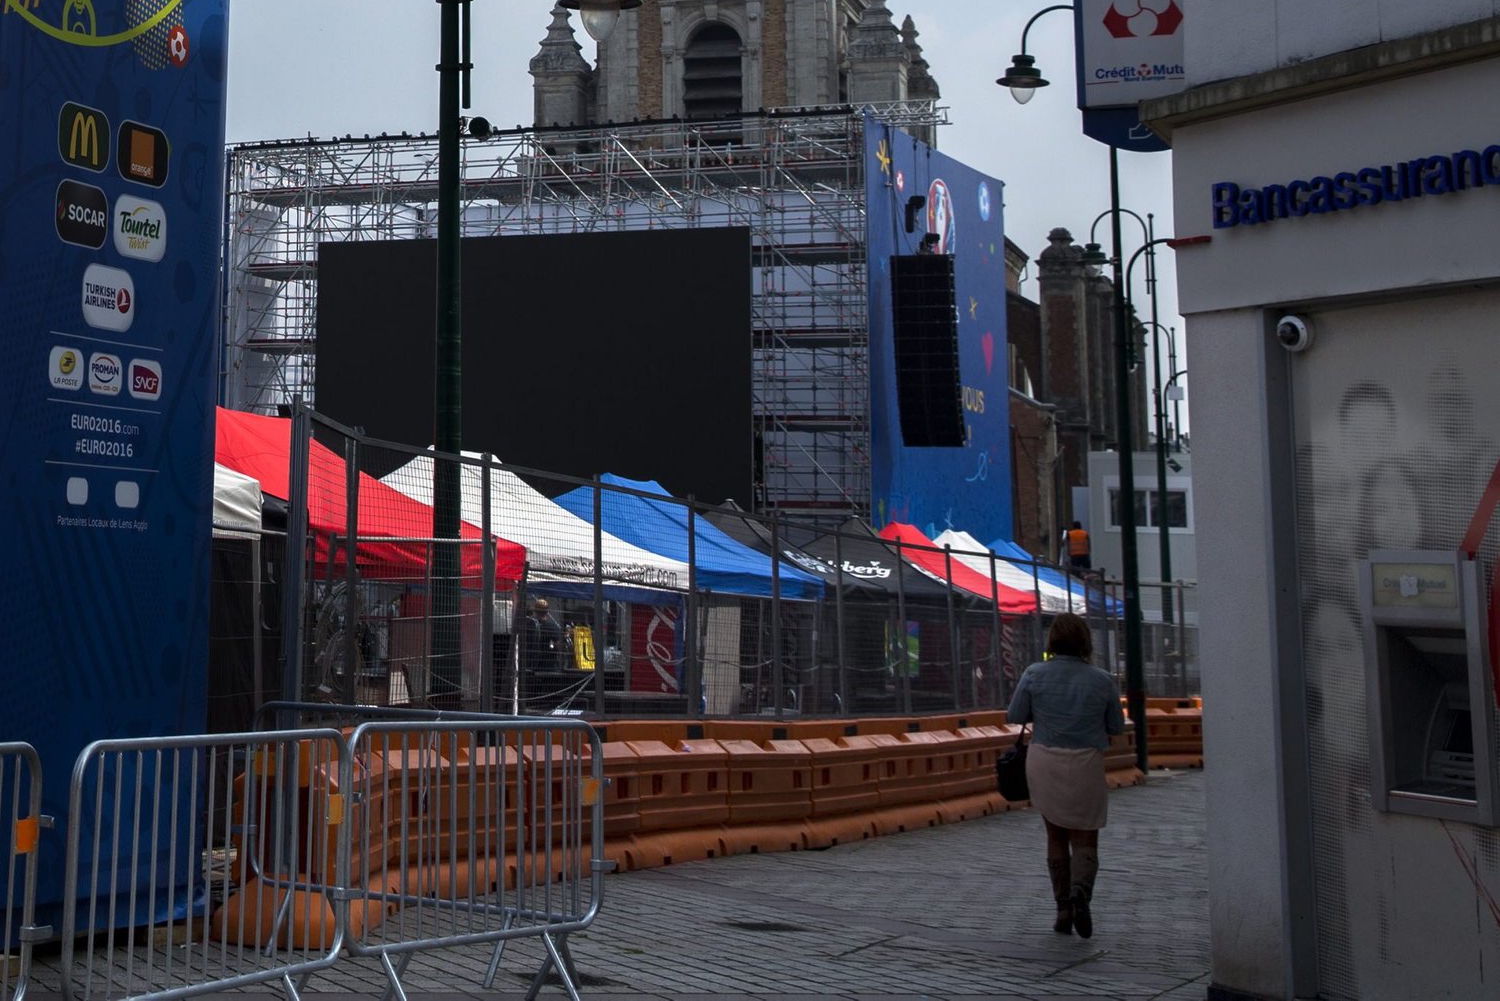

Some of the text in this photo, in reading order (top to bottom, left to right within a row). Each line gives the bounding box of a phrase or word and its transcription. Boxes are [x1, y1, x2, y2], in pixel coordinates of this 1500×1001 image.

[1095, 66, 1135, 79] Crédit
[68, 203, 105, 228] SOCAR
[120, 211, 161, 239] Tourtel
[128, 237, 150, 249] Twist
[85, 282, 116, 298] TURKISH
[85, 296, 116, 310] AIRLINES
[91, 363, 119, 376] PROMAN
[61, 378, 78, 387] POSTE
[134, 376, 157, 390] SNCF
[963, 386, 984, 414] OUS
[71, 413, 139, 436] EURO2016.com
[75, 438, 133, 458] #EURO2016
[57, 515, 87, 527] Partenaires
[88, 518, 108, 528] Locaux
[109, 519, 117, 528] de
[118, 519, 132, 529] Lens
